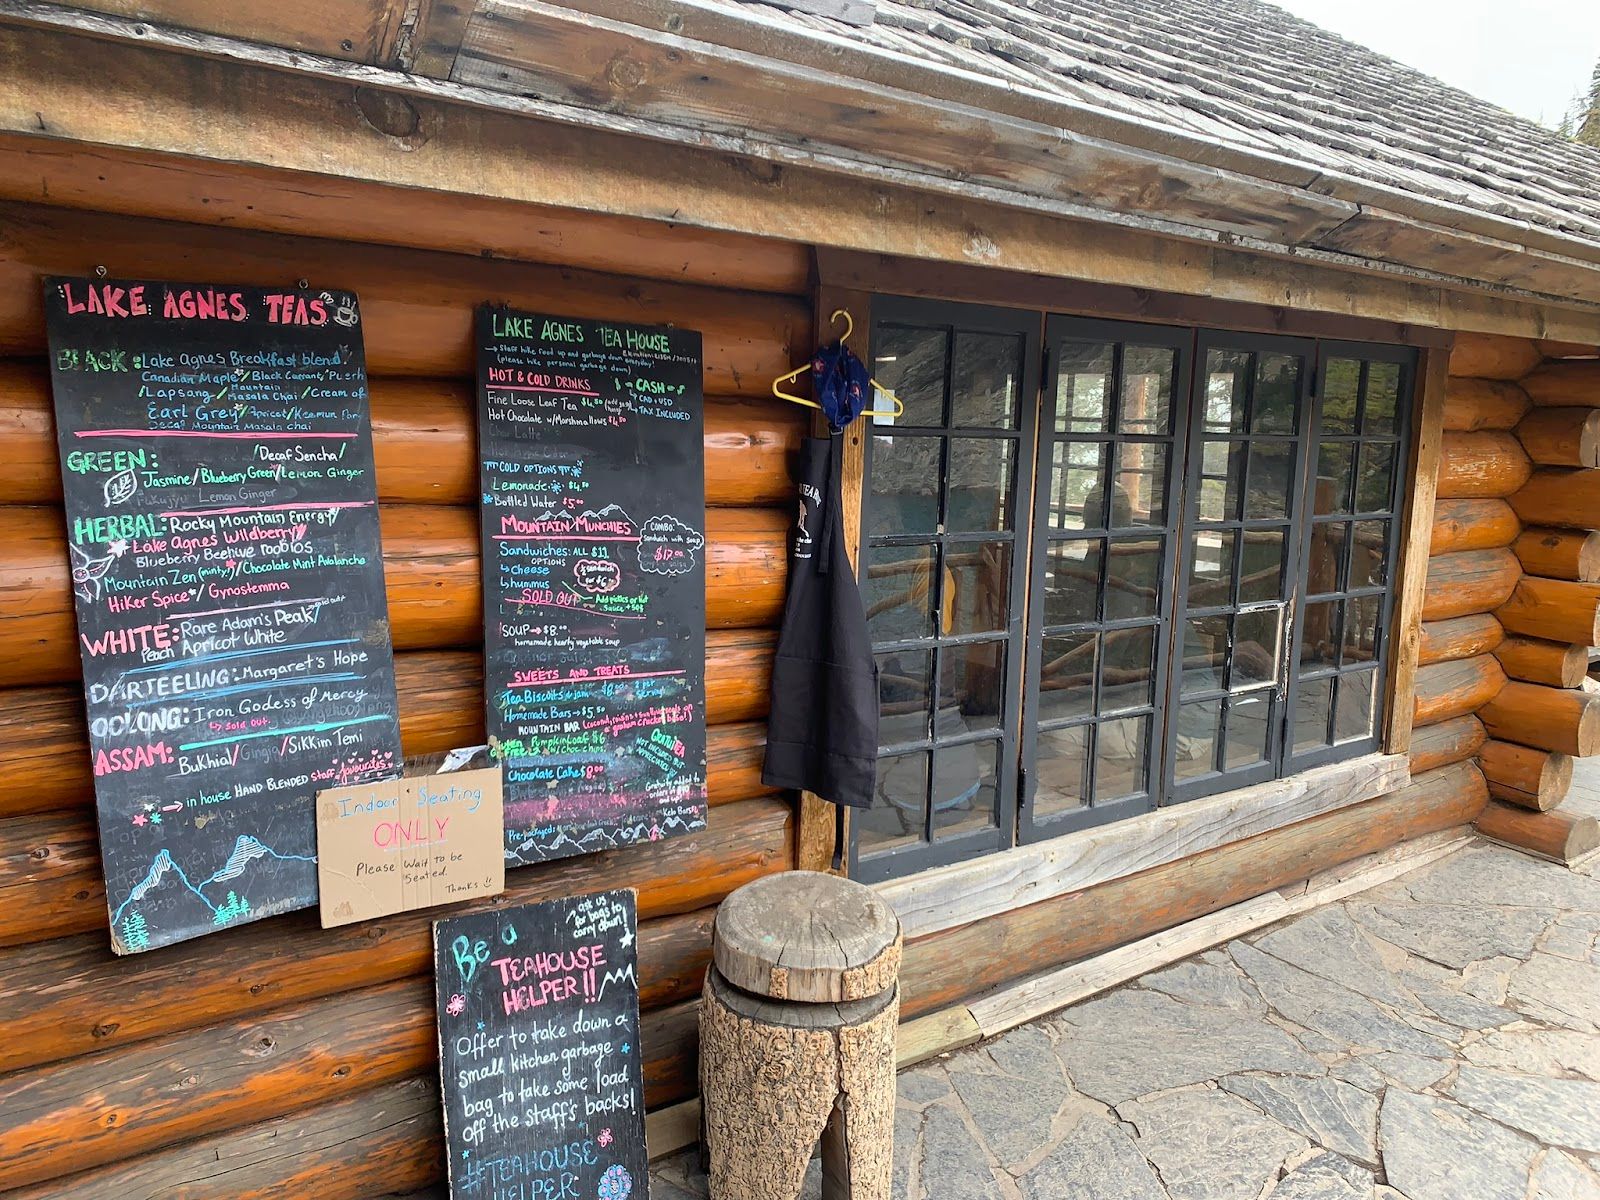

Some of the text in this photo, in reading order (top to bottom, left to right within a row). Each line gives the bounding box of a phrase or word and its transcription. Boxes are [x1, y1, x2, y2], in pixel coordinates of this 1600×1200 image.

[63, 284, 327, 325] LAKE AGNES TEAS
[492, 313, 670, 353] LAKE AGNES TEA HOUSE
[141, 353, 175, 368] Lake
[229, 350, 296, 367] Breakfast
[539, 348, 554, 356] food
[141, 371, 283, 386] Canadian Maple Black
[489, 367, 591, 390] HOT & COLD DRINKS
[636, 378, 665, 394] CASH
[273, 388, 347, 404] Chai Cream
[487, 391, 578, 411] Fine Loose Leaf Tea
[147, 402, 237, 423] Earl Grey
[488, 408, 542, 423] Hot Chocolate
[639, 406, 690, 420] TAX INCLUDED
[66, 448, 159, 474] GREEN:
[259, 445, 338, 463] Decaf Sencha
[141, 466, 364, 488] Jasmine Blueberry Green Ginger
[500, 461, 557, 475] COLD OPTIONS
[492, 477, 547, 491] Lemonade
[494, 493, 557, 508] Bottled Water
[74, 509, 334, 544] HERBAL: Rocky Mountain Energy
[501, 514, 631, 535] MOUNTAIN MUNCHIES
[650, 522, 675, 532] COMBO:
[133, 538, 167, 553] Lake
[223, 524, 301, 544] Wildberry
[500, 541, 571, 557] Sandwiches:
[136, 545, 256, 568] Blueberry Beehive
[104, 555, 316, 592] Mountain Zen Chocolate Mint
[510, 577, 550, 589] hummus
[152, 582, 290, 608] Spice Gynostemma
[522, 588, 577, 605] SOLD OUT
[81, 607, 313, 656] WHITE: Rare Adam's Peak
[502, 624, 530, 637] SOUP
[141, 629, 287, 663] Peach Apricot White
[515, 637, 620, 651] homemade hearty vegetable soup
[242, 650, 368, 680] Margaret's Hope
[514, 665, 630, 682] SWEETS AND TREATS
[193, 707, 234, 723] Iron
[239, 695, 297, 715] Godess
[302, 687, 317, 709] of
[320, 688, 368, 702] Mercy
[502, 690, 522, 704] Tea
[504, 706, 571, 723] Homemade Bars
[518, 721, 580, 735] MOUNTAIN BAR
[94, 727, 363, 776] ASSAM: Temi
[508, 766, 580, 781] Chocolate Cake
[199, 790, 232, 805] house
[235, 784, 263, 798] HAND
[266, 775, 308, 791] BLENDED
[337, 796, 399, 818] Indoor
[417, 786, 482, 813] Seating
[374, 816, 450, 848] ONLY
[356, 852, 463, 876] Please Wait to be
[445, 882, 478, 893] Thanks
[578, 895, 607, 912] ask us
[574, 902, 622, 928] for bags to
[573, 925, 597, 939] carry
[452, 923, 518, 982] Be a
[491, 944, 607, 986] TEAHOUSE
[502, 968, 596, 1016] HELPER!!
[456, 1009, 628, 1060] Offer to take down a
[458, 1041, 613, 1088] small kitchen garbage
[462, 1064, 629, 1118] bag to take some load
[462, 1088, 636, 1146] off the staff's backs!
[457, 1140, 598, 1193] #TEAHOUSE
